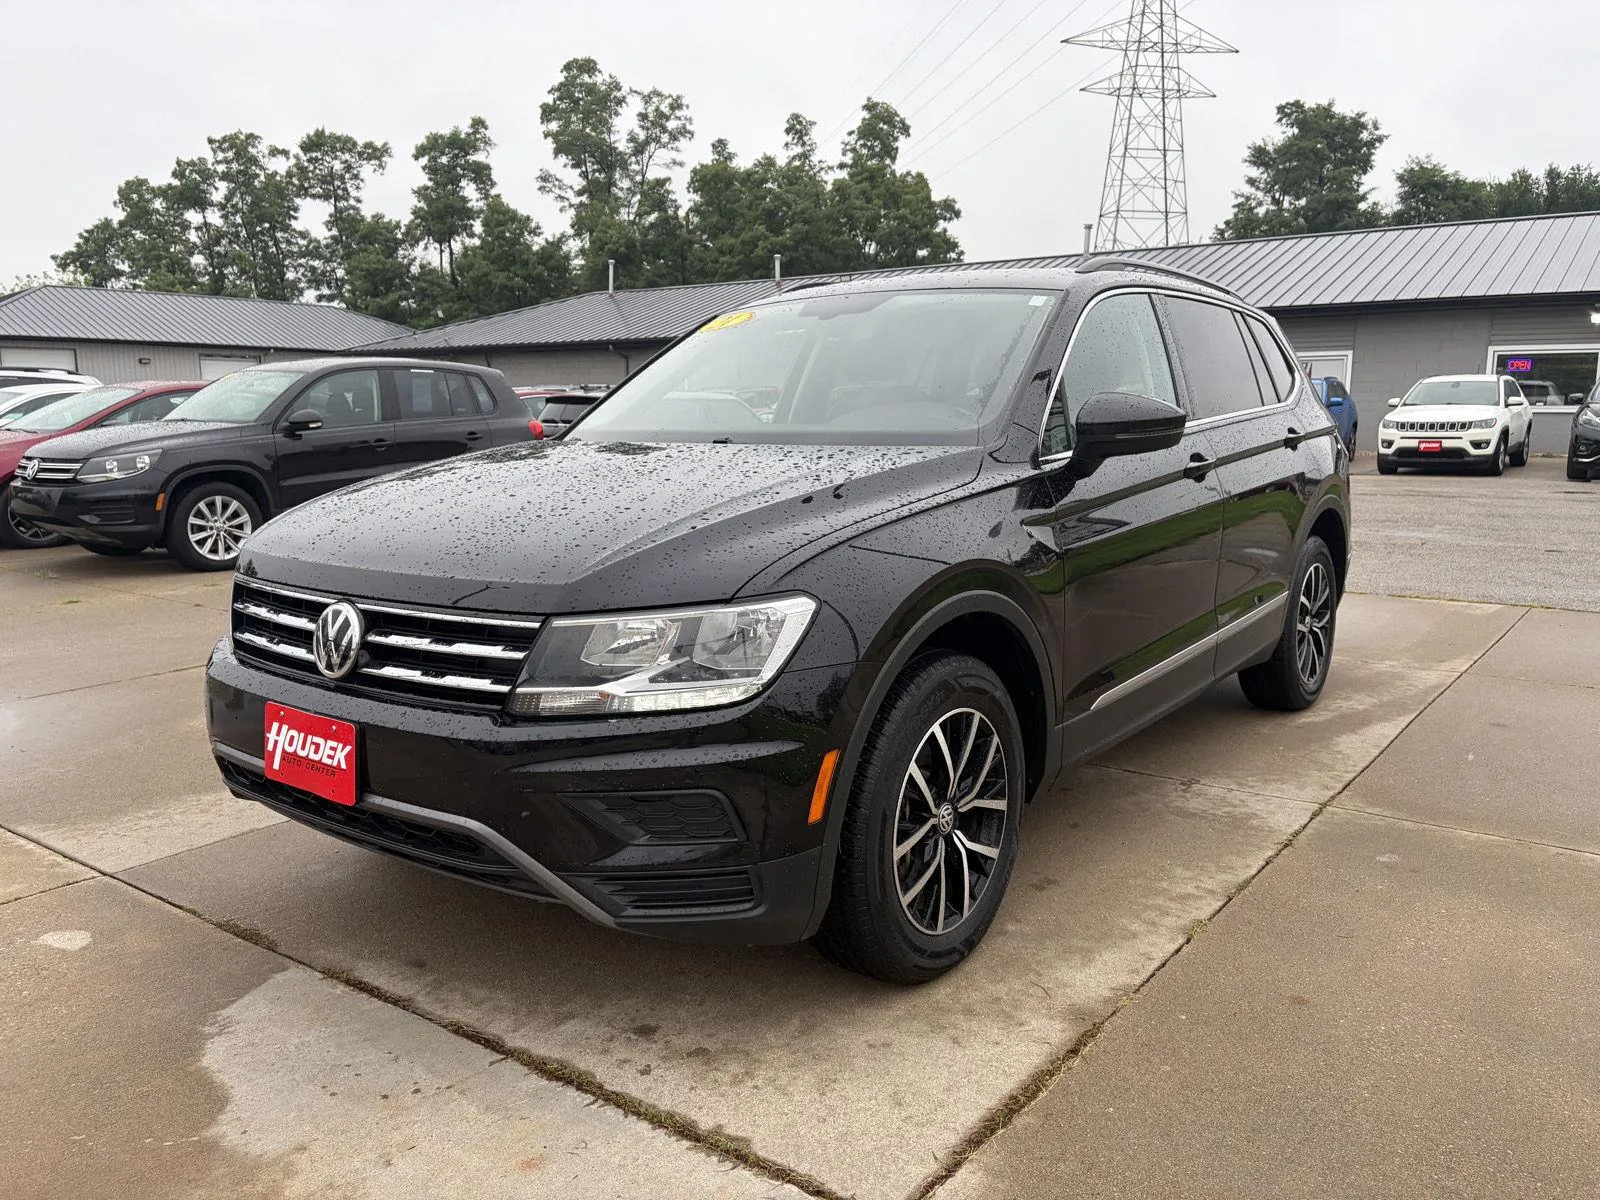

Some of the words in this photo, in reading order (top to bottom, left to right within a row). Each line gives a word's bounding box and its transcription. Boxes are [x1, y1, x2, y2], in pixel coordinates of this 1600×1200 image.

[1508, 360, 1531, 370] OPEN
[313, 601, 362, 679] VW
[266, 722, 352, 770] HOUDEK
[282, 756, 302, 767] AUTO
[305, 762, 336, 778] CENTER
